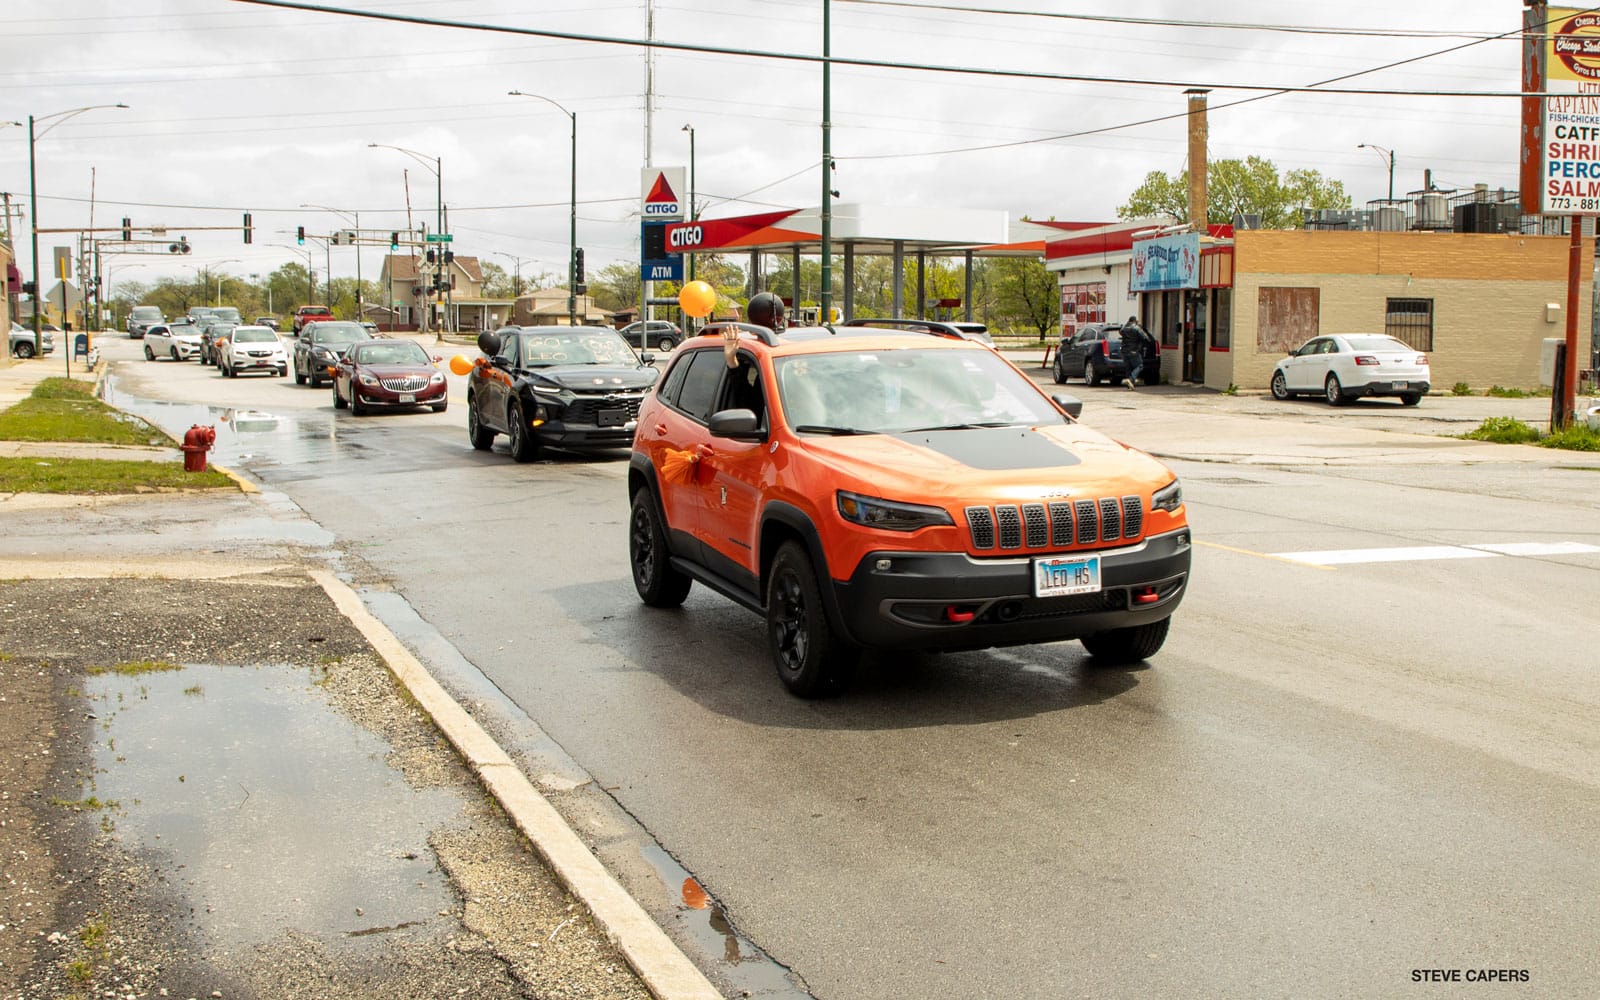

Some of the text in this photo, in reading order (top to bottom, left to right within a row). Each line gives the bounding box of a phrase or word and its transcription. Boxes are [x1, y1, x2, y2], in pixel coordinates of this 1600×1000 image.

[1573, 63, 1589, 76] Gyros
[1578, 81, 1600, 93] LITT
[1548, 95, 1598, 115] CAPTAIN
[1548, 142, 1600, 161] SHRI
[1549, 161, 1600, 179] PERC
[1548, 180, 1600, 198] SALM
[645, 204, 678, 214] CITGO
[1551, 198, 1570, 208] 773
[1580, 199, 1599, 210] 881
[670, 226, 703, 247] CITGO
[1148, 245, 1167, 261] SEAFOOD
[651, 266, 672, 278] ATM
[528, 337, 560, 348] GO
[528, 345, 567, 361] LEO
[1075, 567, 1089, 585] HS
